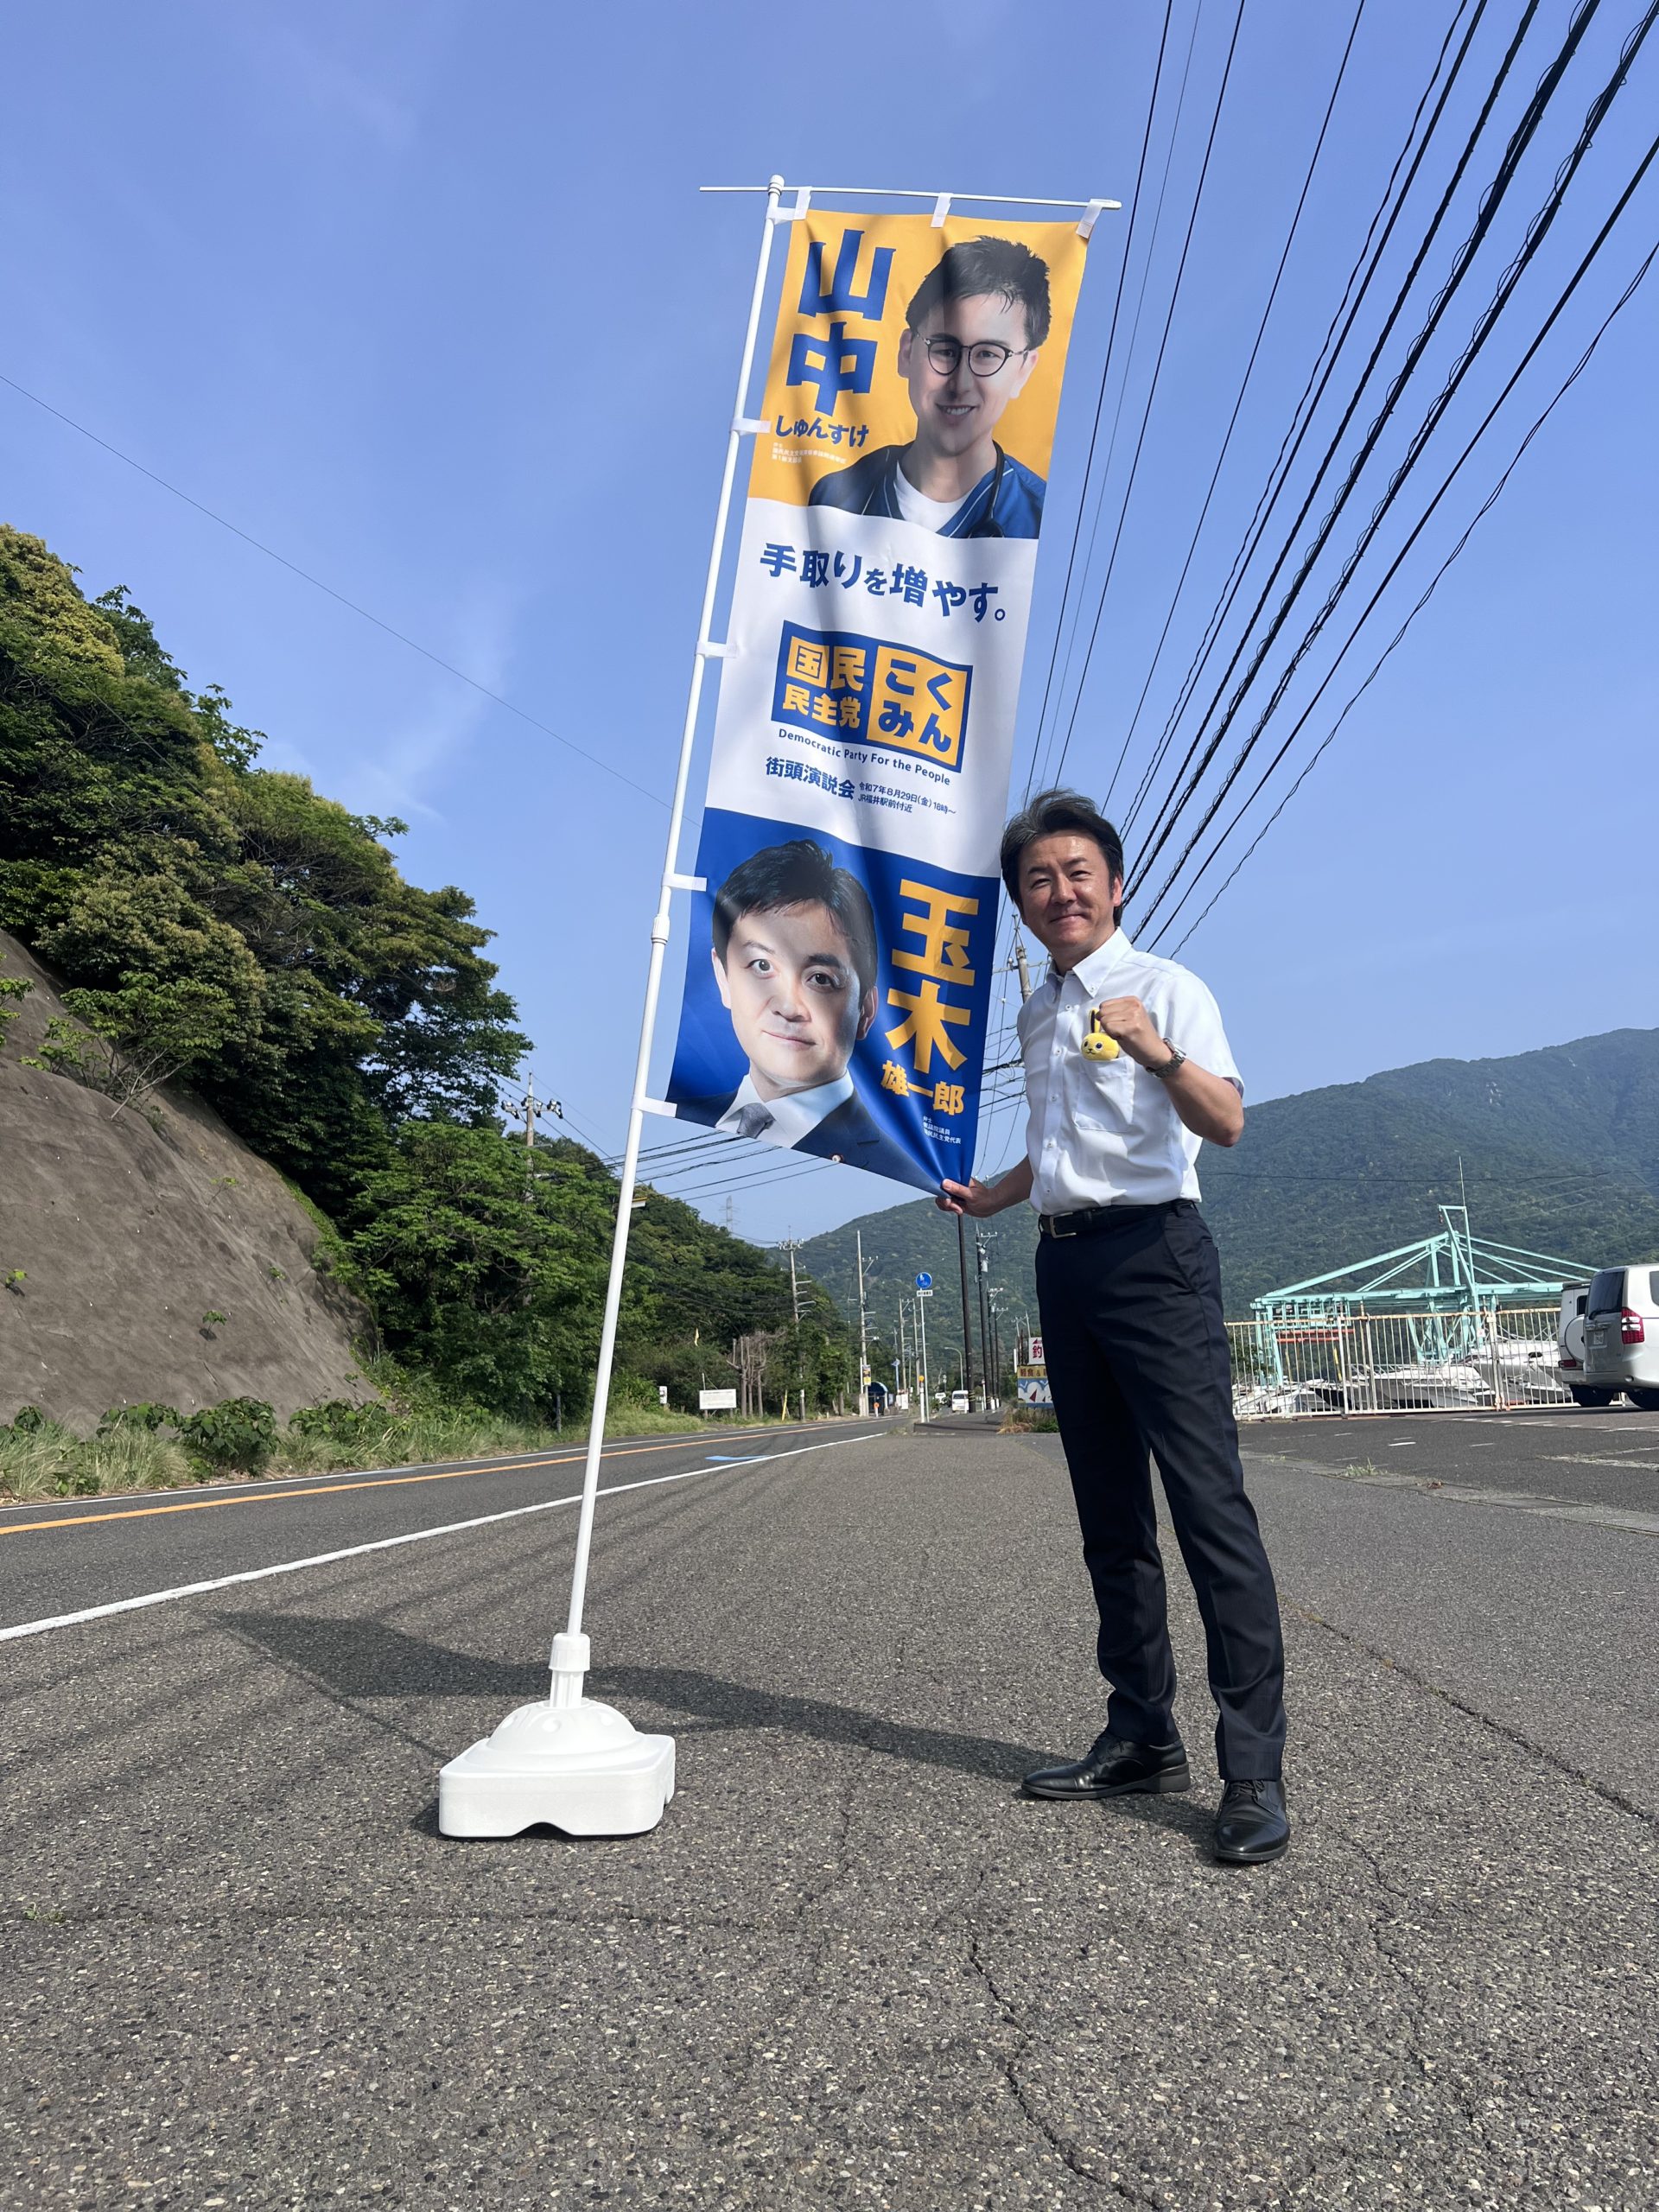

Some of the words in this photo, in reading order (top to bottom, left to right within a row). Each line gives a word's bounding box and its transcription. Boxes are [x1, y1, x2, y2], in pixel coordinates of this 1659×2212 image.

[786, 229, 896, 416] 山中
[776, 415, 869, 448] しゅんすけ
[760, 543, 1006, 623] 手取りを増やす。
[786, 636, 867, 691] 国民
[886, 658, 953, 712] こく
[782, 683, 861, 729] 民主党
[878, 699, 952, 753] みん
[766, 756, 855, 800] 街頭演説会
[779, 728, 842, 758] Democratic
[843, 748, 868, 764] Party
[871, 753, 890, 766] For
[893, 759, 912, 772] the
[915, 766, 950, 785] People
[858, 793, 913, 813] JR福井駅前付近
[885, 879, 979, 1074] 玉木
[880, 1059, 965, 1116] 雄一郎
